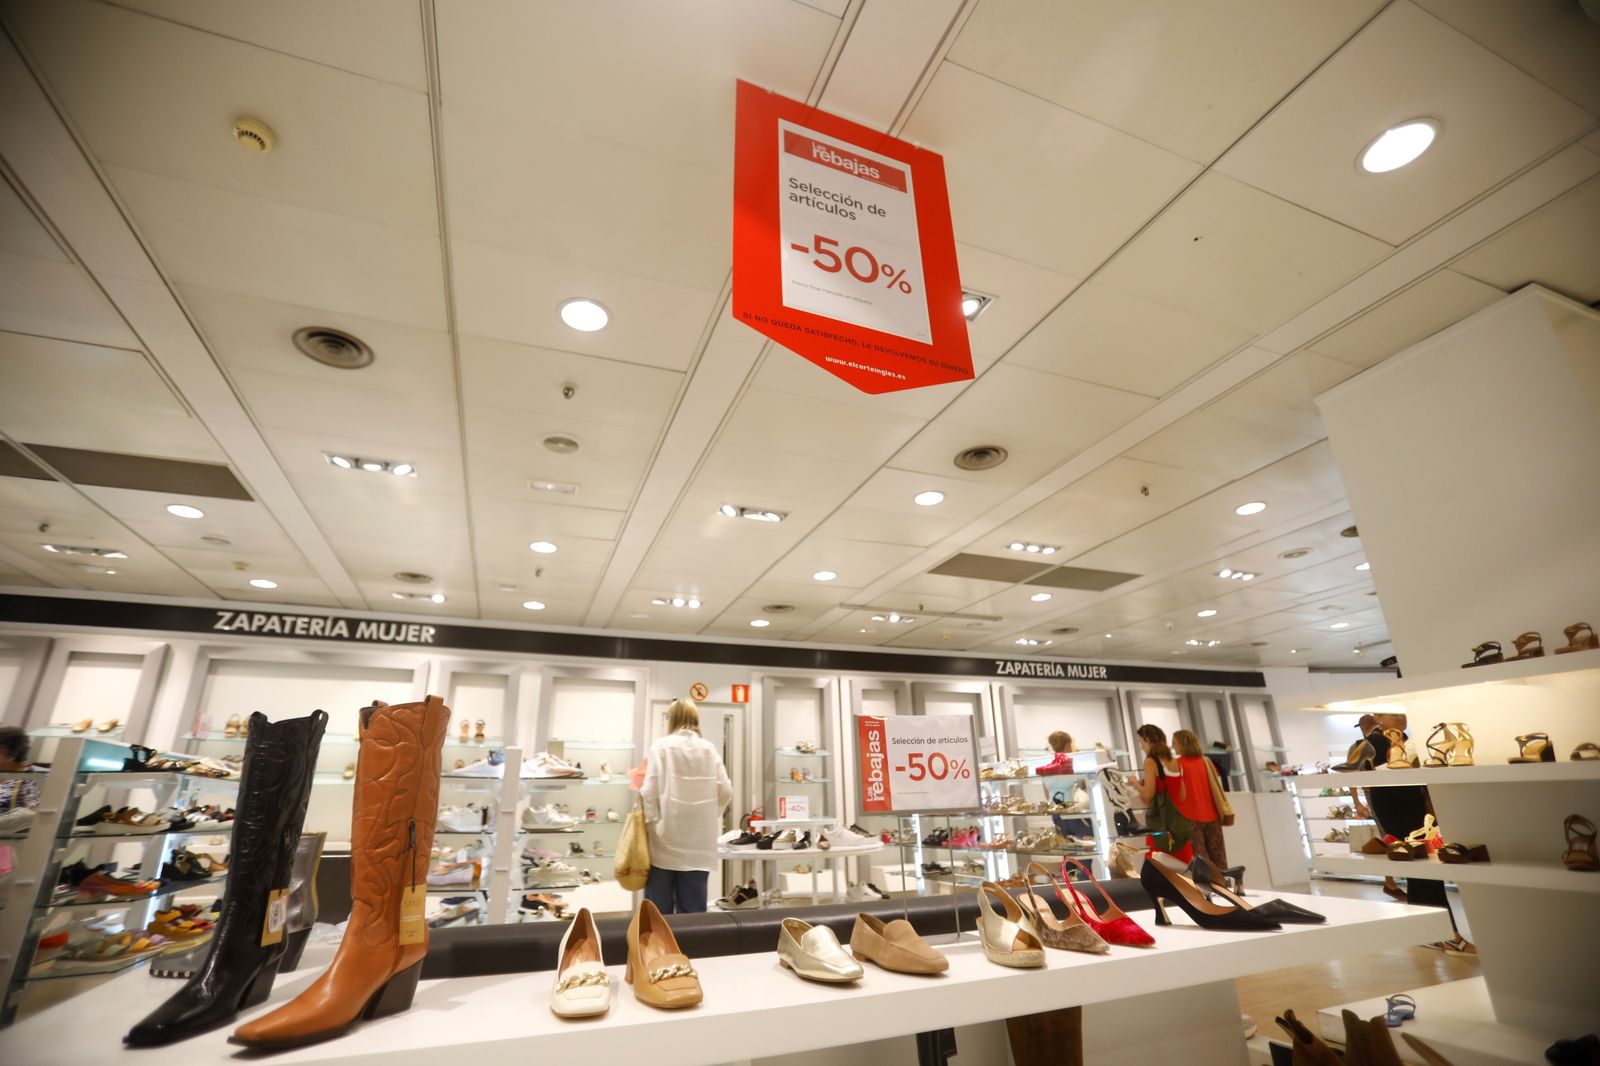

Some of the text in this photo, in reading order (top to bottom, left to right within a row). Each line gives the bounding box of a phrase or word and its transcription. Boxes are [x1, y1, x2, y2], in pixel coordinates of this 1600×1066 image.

[812, 148, 880, 179] rebajas
[789, 177, 863, 210] Selección
[867, 204, 887, 217] de
[789, 192, 856, 221] artículos
[790, 234, 912, 294] -50%
[755, 315, 768, 323] NO
[771, 318, 802, 331] QUEDA
[862, 342, 872, 350] LE
[874, 344, 928, 364] DEVOLVEMOS
[825, 356, 906, 380] www.elcorteingles.es
[213, 611, 436, 643] ZAPATERÍA MUJER
[995, 660, 1107, 679] ZAPATERÍA MUJER
[891, 736, 969, 745] Selección de artículos
[867, 729, 885, 801] rebajas
[895, 752, 971, 782] -50%
